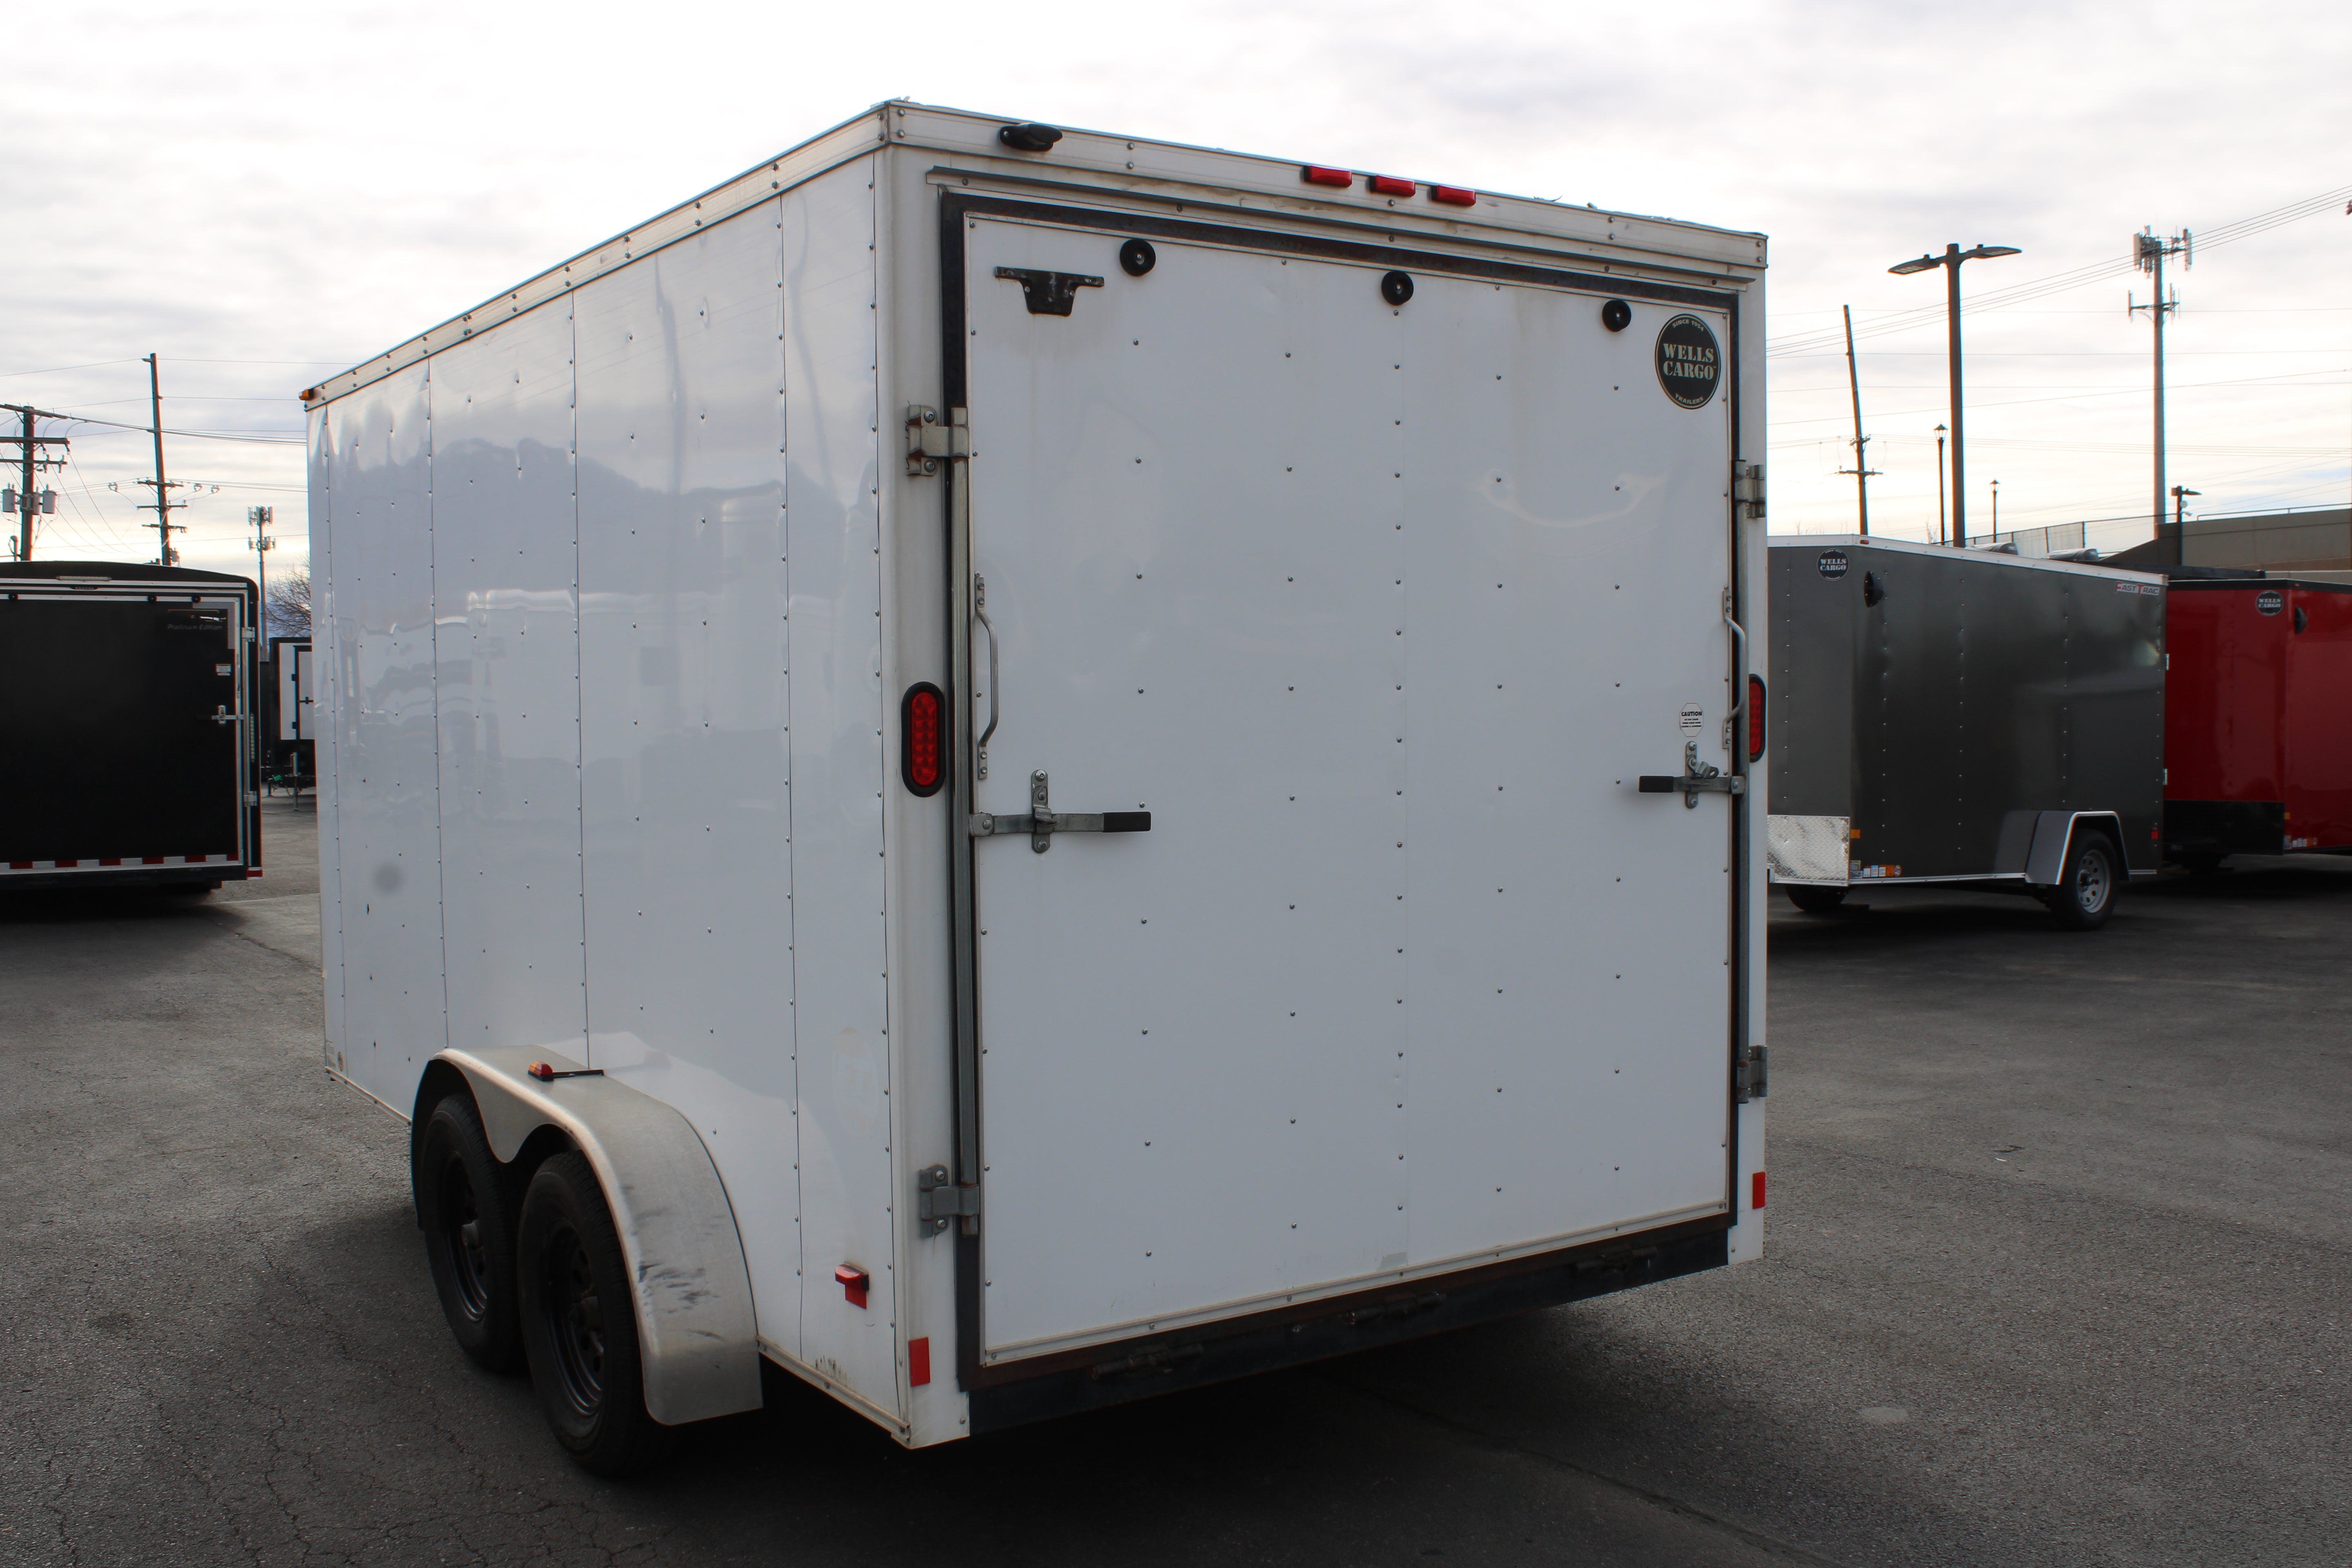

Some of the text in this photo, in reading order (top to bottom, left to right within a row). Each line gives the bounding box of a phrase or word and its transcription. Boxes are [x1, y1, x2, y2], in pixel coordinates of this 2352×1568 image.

[1672, 319, 1704, 332] SINCE 1954
[1663, 343, 1714, 363] WELLS
[1663, 361, 1714, 380] CARGO
[1675, 393, 1704, 404] TRAILERS
